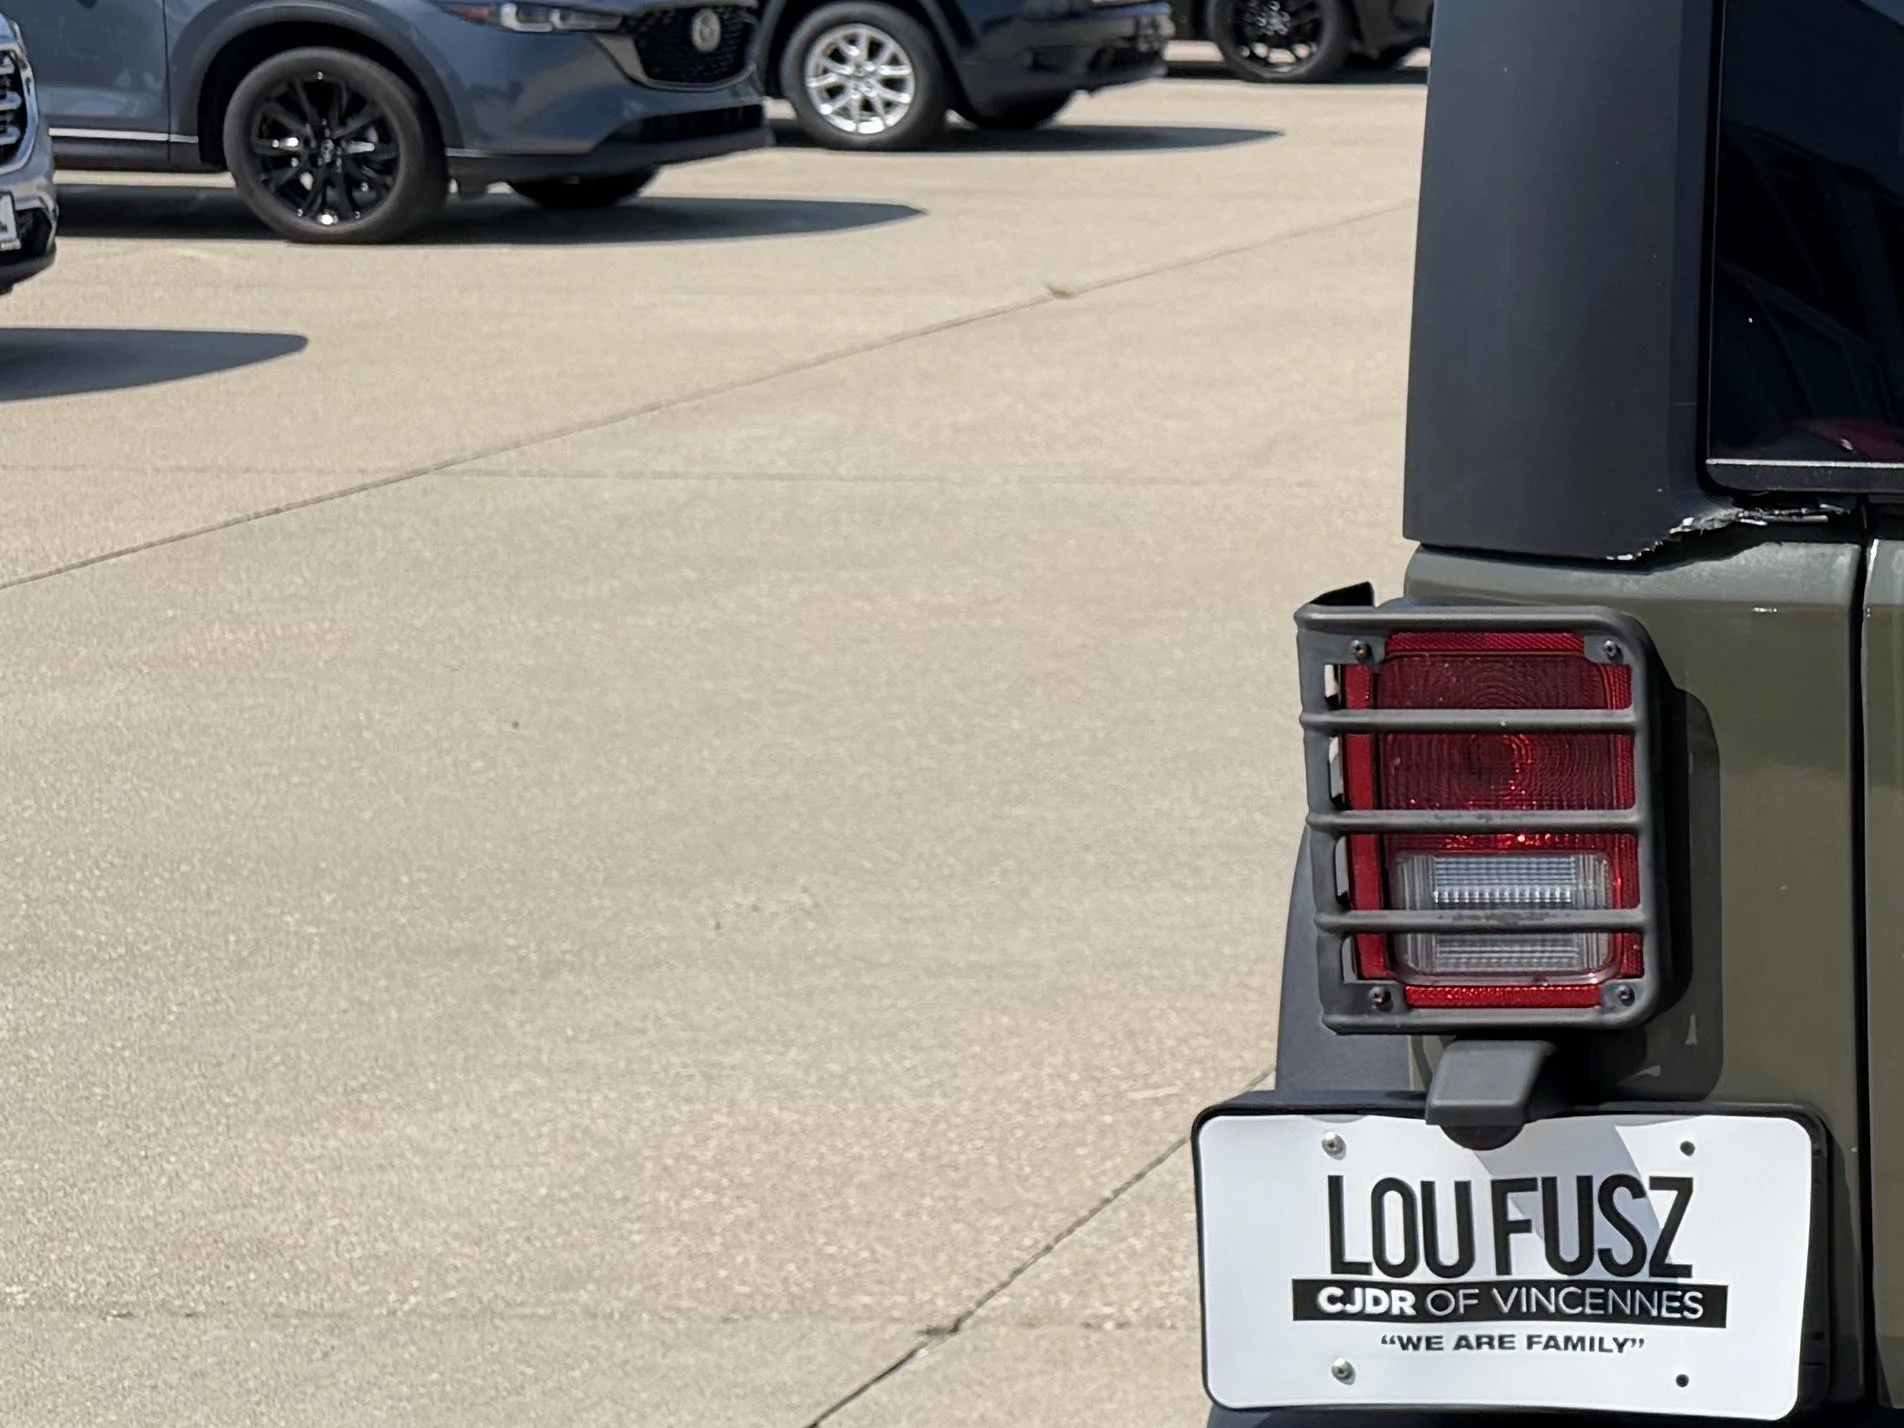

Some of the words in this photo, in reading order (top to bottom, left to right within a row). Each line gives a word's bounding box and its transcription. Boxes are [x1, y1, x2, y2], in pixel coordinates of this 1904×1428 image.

[1317, 1287, 1417, 1317] CJDR
[1424, 1287, 1479, 1317] OF
[1491, 1287, 1704, 1320] VINCENNES
[1453, 1333, 1516, 1352] ARE
